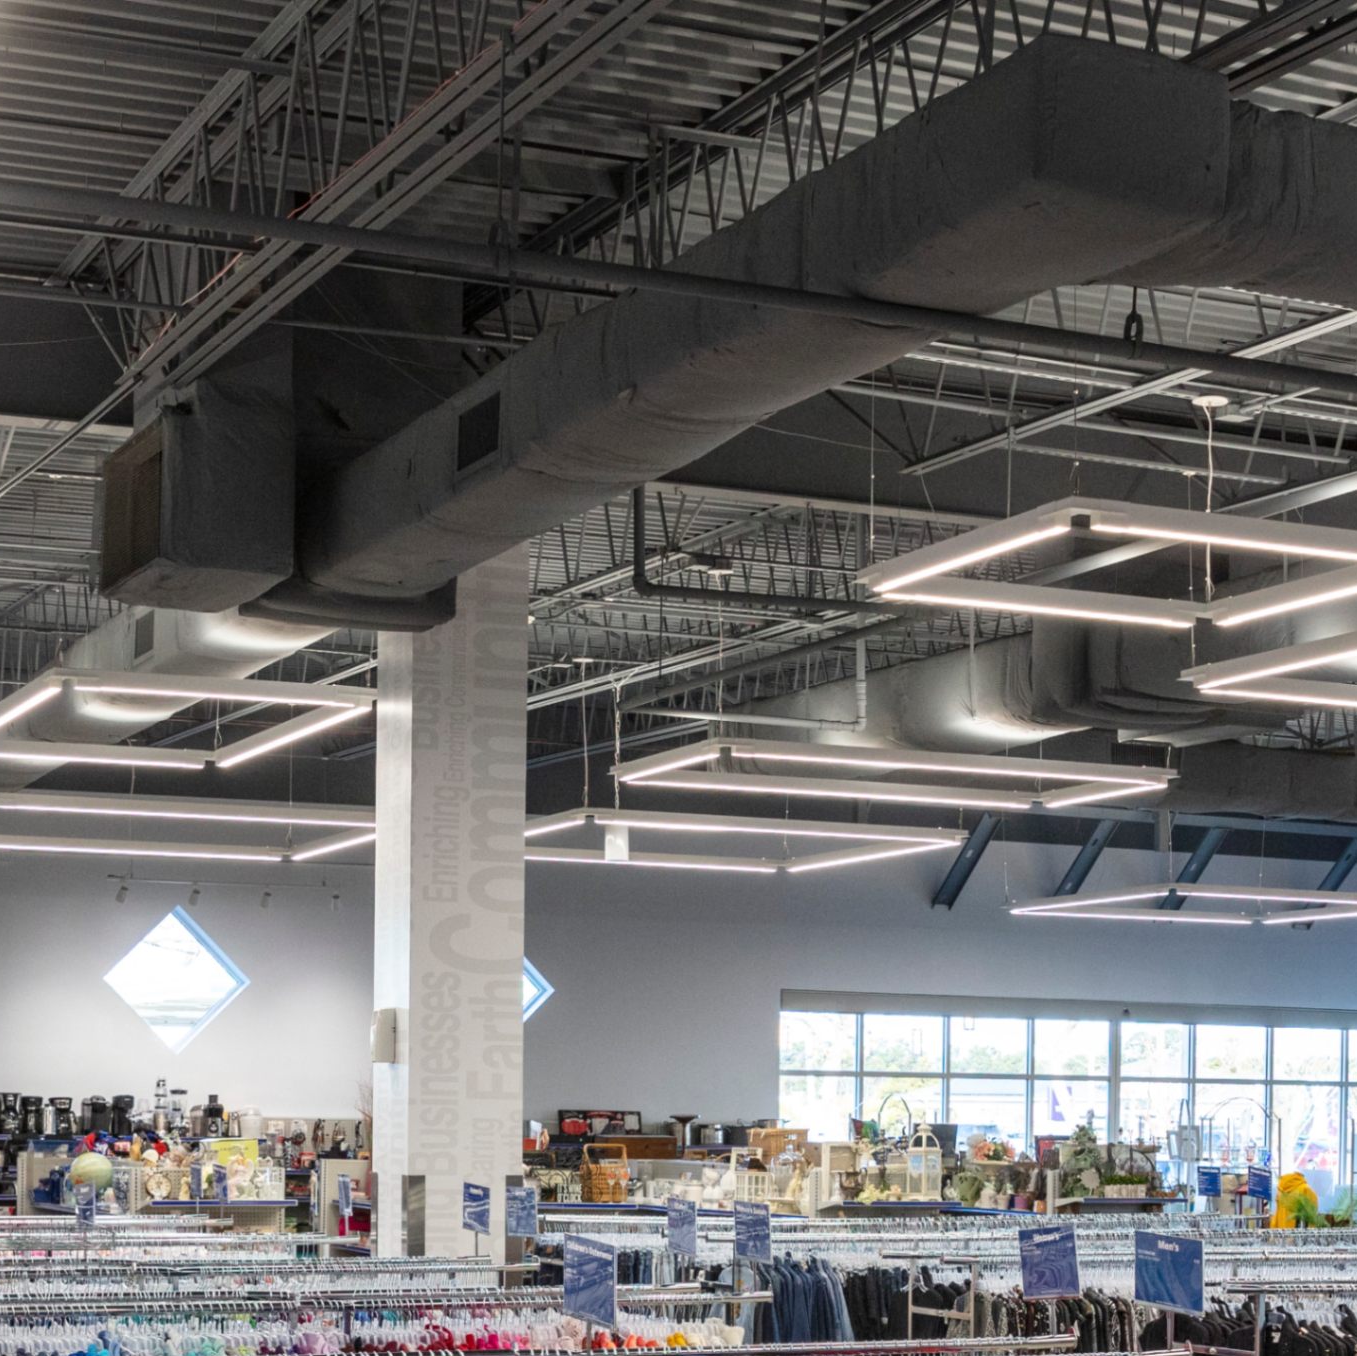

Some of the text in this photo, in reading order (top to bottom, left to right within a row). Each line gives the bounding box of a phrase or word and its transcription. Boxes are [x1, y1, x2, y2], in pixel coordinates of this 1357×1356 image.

[422, 787, 470, 903] Enriching
[409, 971, 461, 1176] Businesses
[1157, 1239, 1179, 1252] Men's
